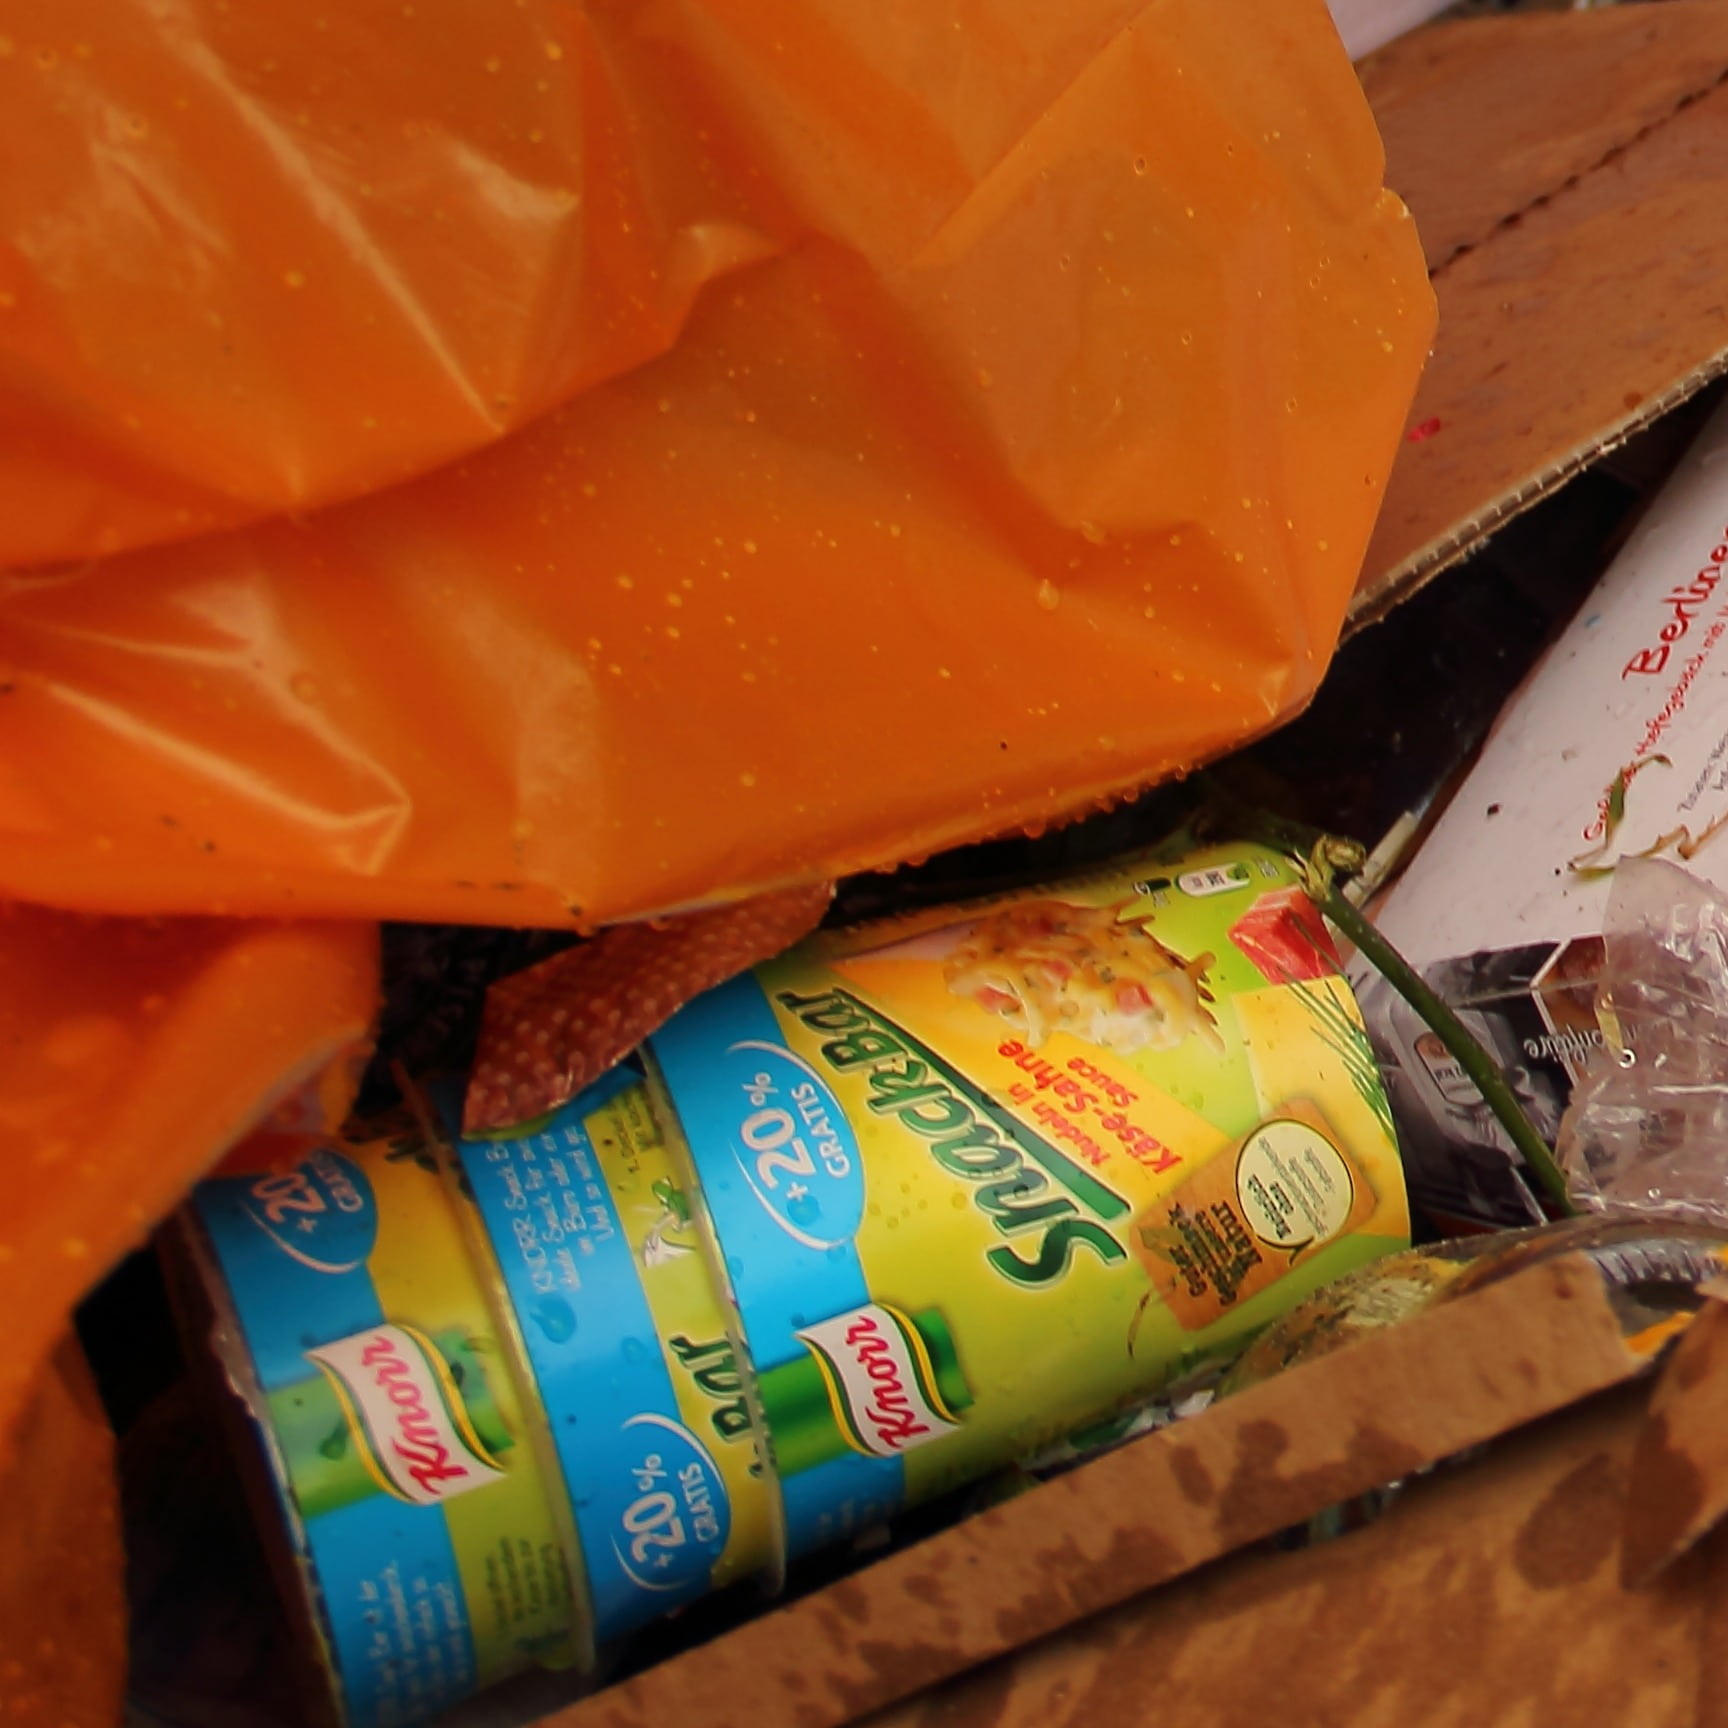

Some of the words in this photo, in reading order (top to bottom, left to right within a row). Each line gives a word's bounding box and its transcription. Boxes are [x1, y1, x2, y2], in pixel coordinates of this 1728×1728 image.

[791, 1081, 851, 1178] GRATIS
[995, 1038, 1183, 1177] Käse-Sahne
[1067, 1055, 1137, 1114] Sauce
[360, 1338, 478, 1496] Knorr
[845, 1315, 931, 1452] Knorr
[678, 1461, 722, 1544] GRATIS
